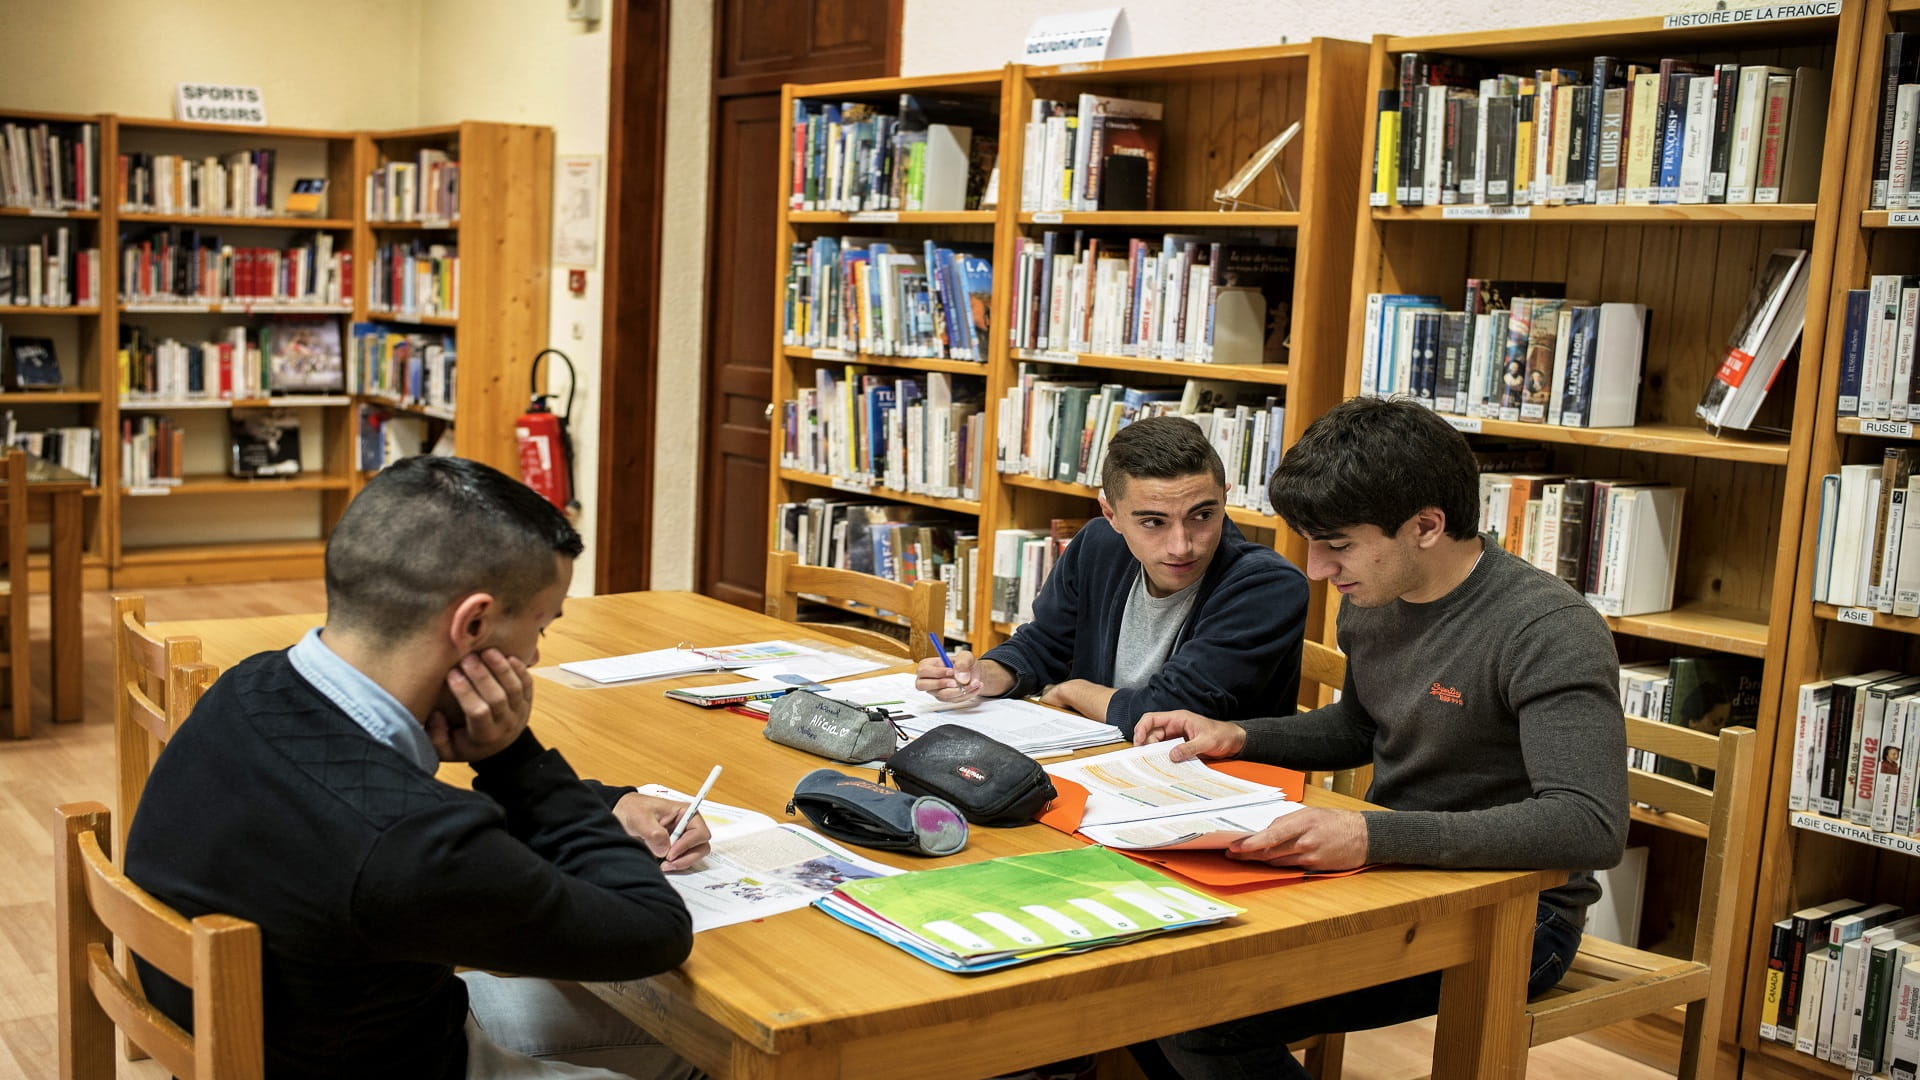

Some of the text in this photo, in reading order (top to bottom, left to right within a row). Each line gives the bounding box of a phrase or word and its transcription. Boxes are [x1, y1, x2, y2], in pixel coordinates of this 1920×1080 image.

[1668, 2, 1837, 27] HISTOIRE DE LA FRANCE
[183, 85, 259, 102] SPORTS
[1693, 81, 1706, 115] Jack Lang
[1887, 74, 1898, 105] mondiale
[185, 105, 262, 121] LOISIRS
[1883, 107, 1895, 130] Guerre
[1600, 113, 1621, 167] LOUIS XI
[1663, 120, 1678, 170] FRANÇOIS
[1687, 134, 1697, 158] François
[1880, 133, 1892, 161] Première
[1893, 140, 1909, 188] LES POILUS
[966, 260, 989, 272] LA
[1569, 332, 1582, 395] LE LIVRE NOIR
[1849, 353, 1858, 372] RUSSIE
[1866, 422, 1908, 434] RUSSIE
[1843, 610, 1868, 621] ASIE
[810, 714, 838, 736] Alicia
[1858, 737, 1878, 799] CONVOI 42
[1797, 816, 1820, 829] ASIE
[1896, 840, 1913, 851] DU
[1767, 972, 1779, 1003] CANADA
[1904, 1029, 1914, 1038] Les
[1906, 1016, 1916, 1028] Noirs
